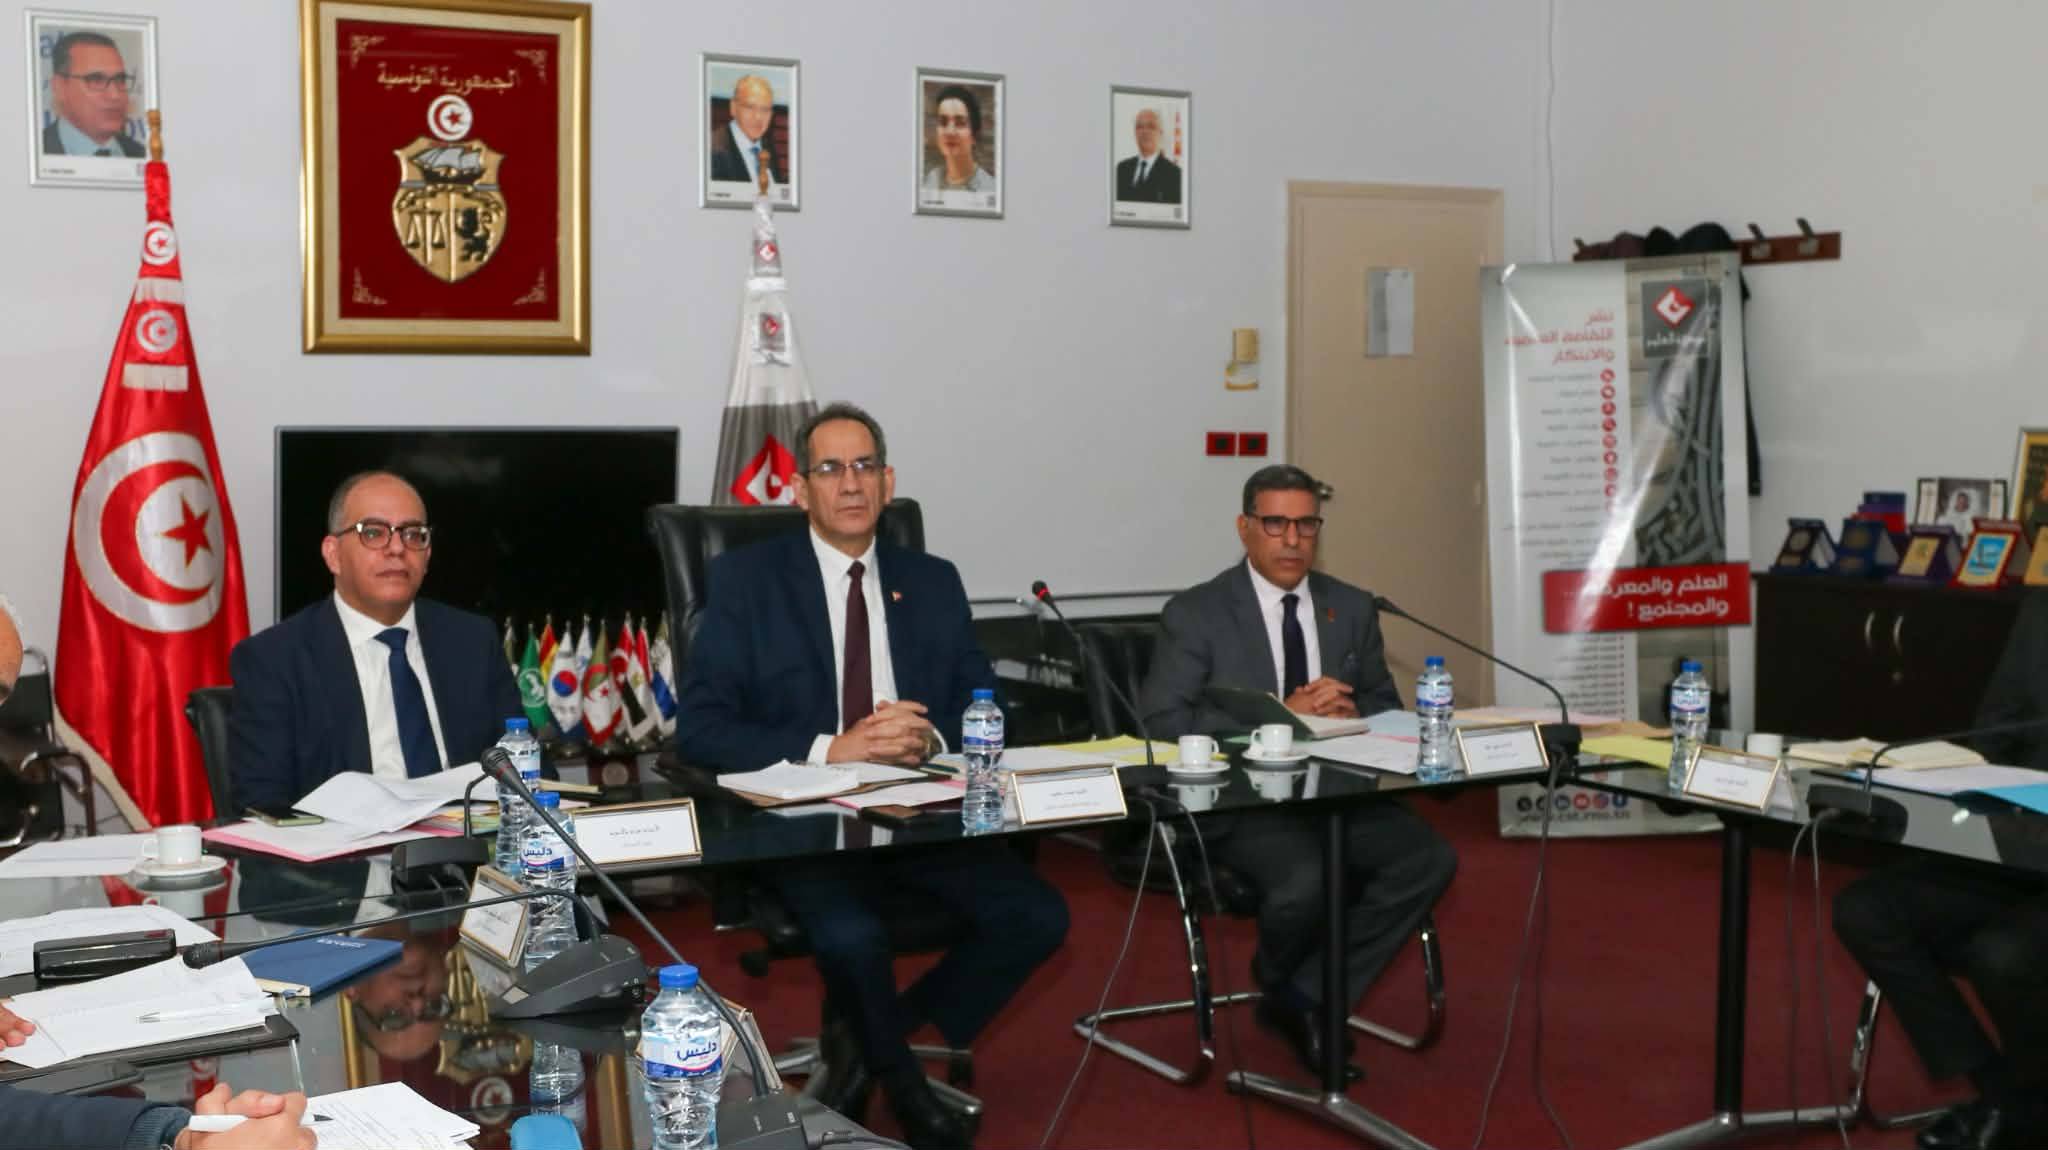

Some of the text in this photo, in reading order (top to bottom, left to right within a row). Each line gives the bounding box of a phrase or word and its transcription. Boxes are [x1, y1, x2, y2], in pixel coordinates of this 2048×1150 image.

[376, 61, 521, 96] الجمهورية التونسية
[1677, 574, 1728, 596] العلم
[1638, 598, 1729, 621] والمجتمع
[676, 1040, 718, 1061] دليس
